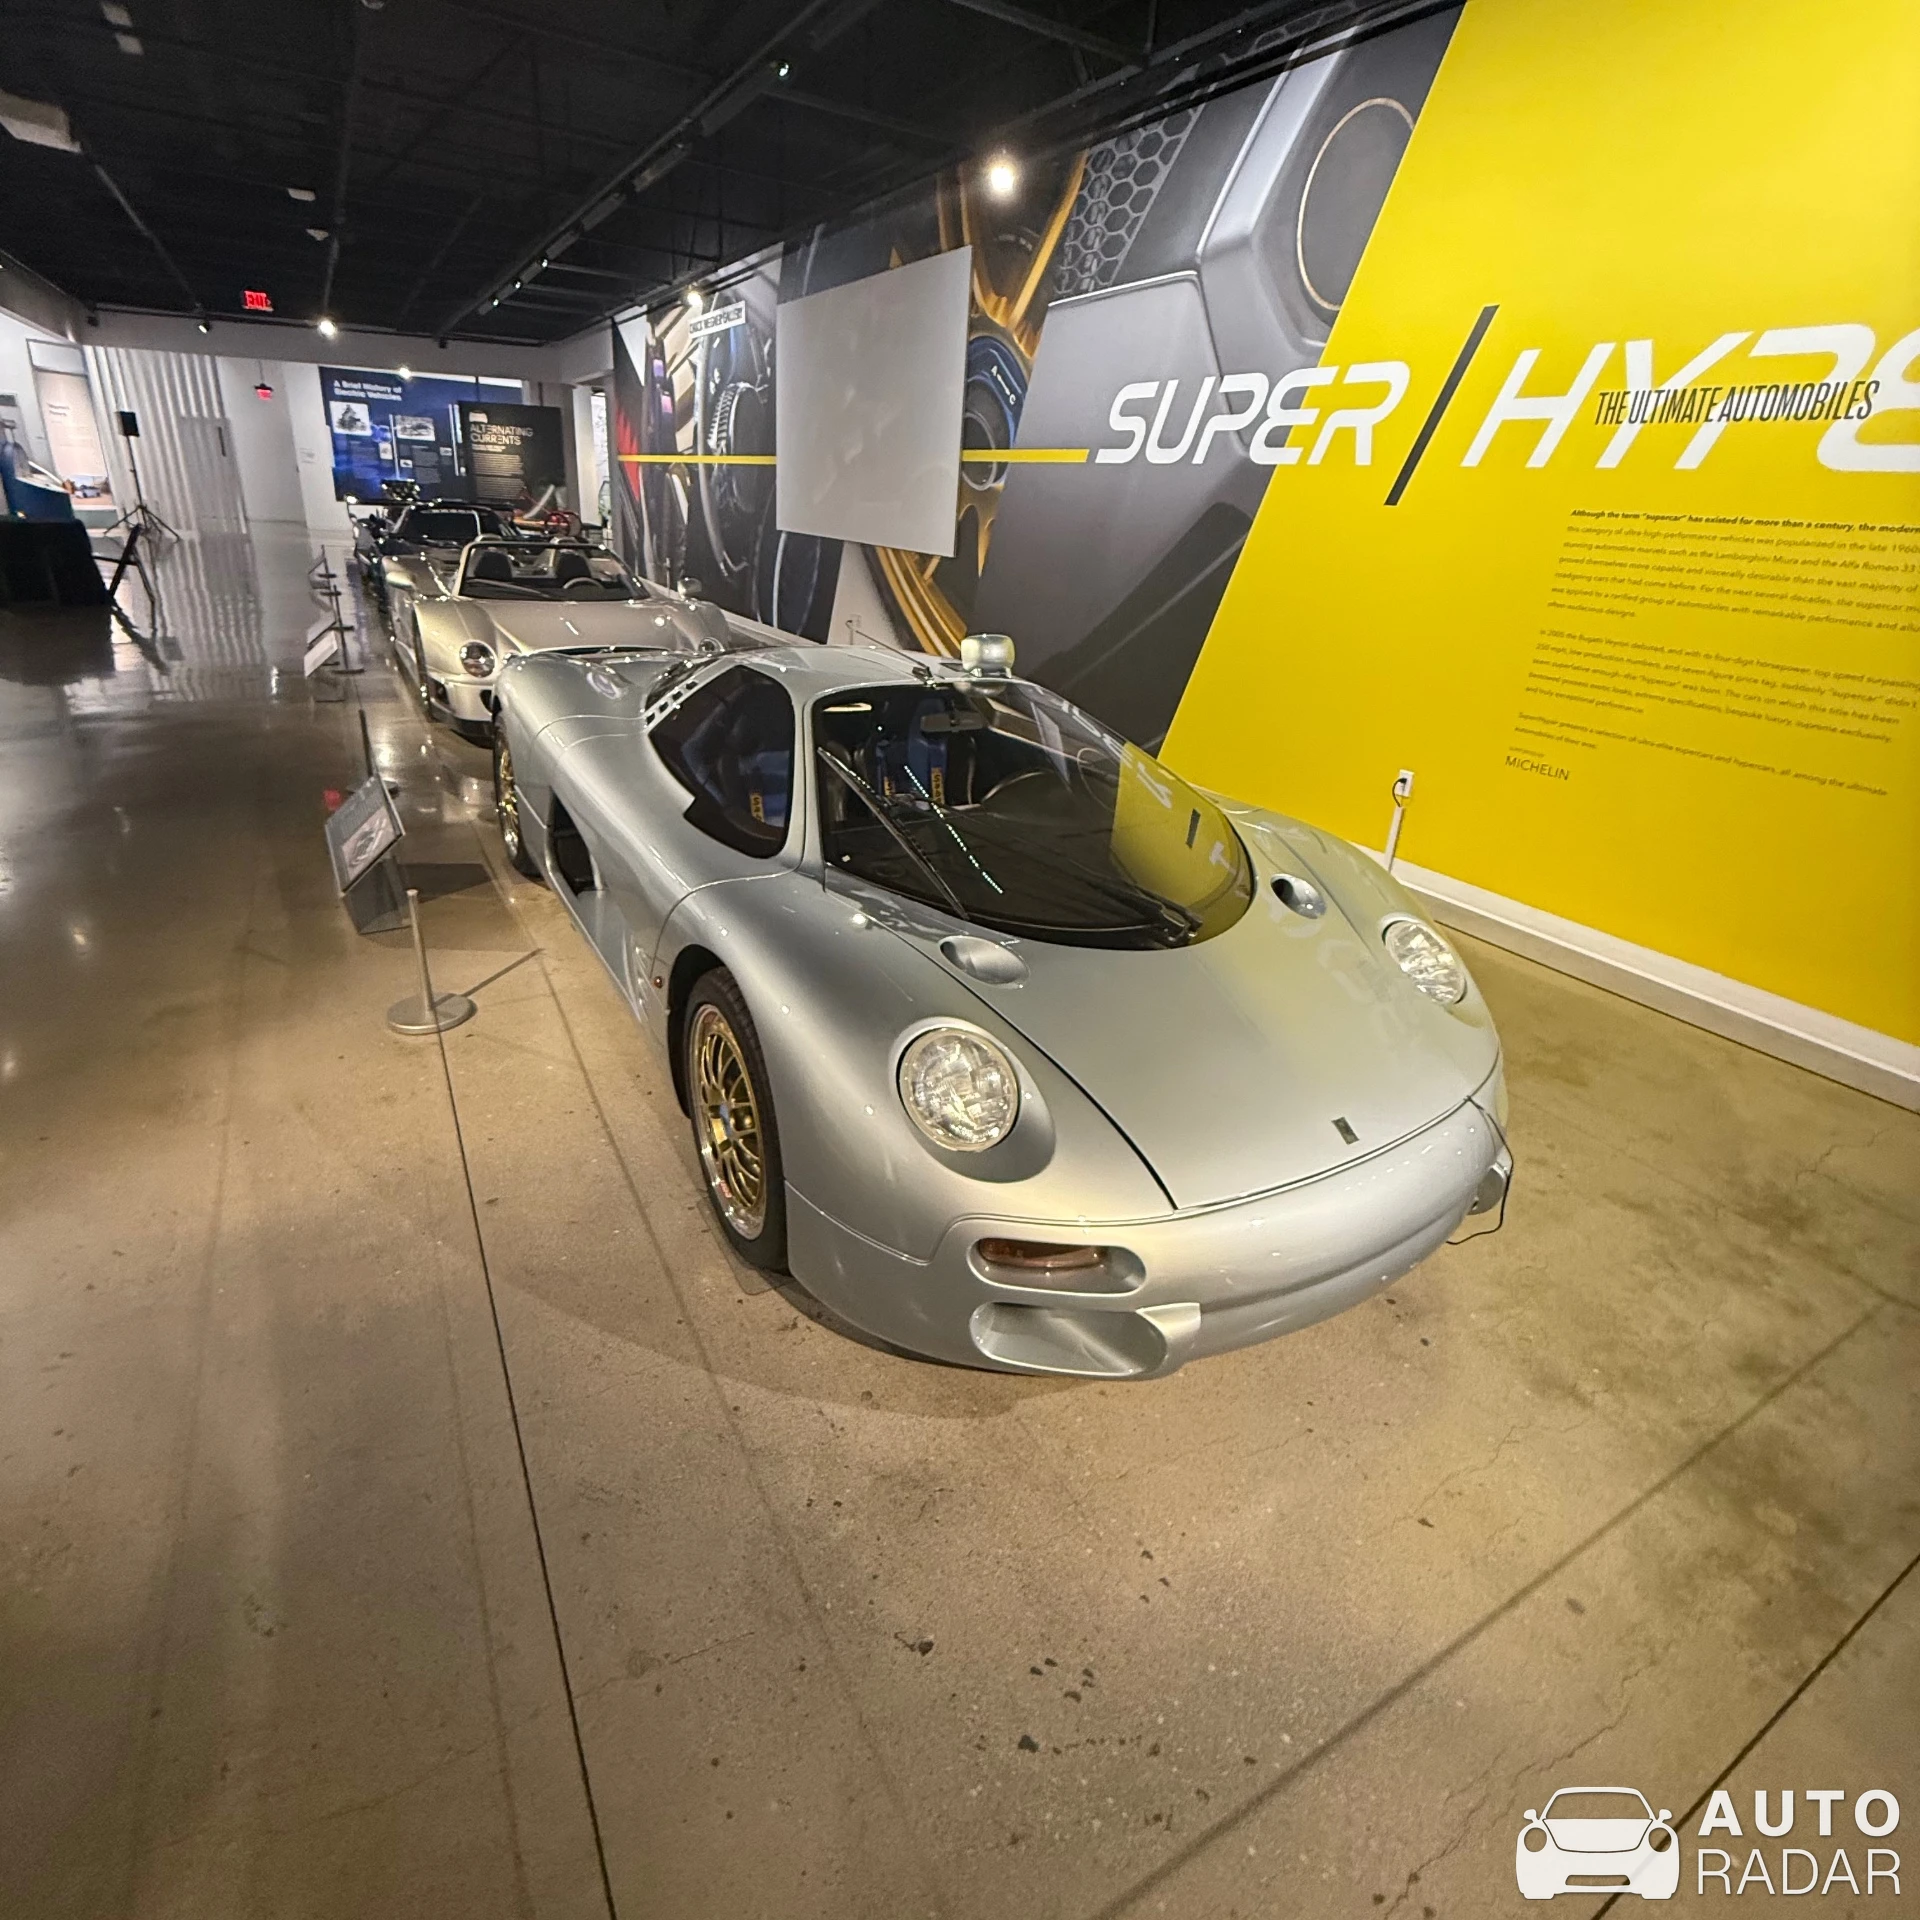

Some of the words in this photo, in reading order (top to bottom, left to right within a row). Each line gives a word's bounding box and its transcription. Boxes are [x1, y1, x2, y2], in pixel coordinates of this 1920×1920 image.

[1095, 360, 1410, 466] SUPER
[1595, 390, 1631, 426] THE
[1627, 386, 1723, 425] ULTIMATE
[1717, 380, 1881, 423] AUTOMOBILES
[470, 423, 534, 437] ALTERNATING
[470, 432, 522, 446] CURRENTS
[1571, 509, 1605, 519] Although
[1688, 514, 1702, 522] has
[1704, 516, 1737, 524] existed
[1739, 516, 1753, 525] for
[1782, 518, 1803, 527] than
[1859, 522, 1876, 531] the
[1849, 541, 1866, 550] the
[1868, 543, 1887, 552] late
[1700, 550, 1713, 558] the
[1773, 554, 1798, 564] Miura
[1800, 558, 1820, 566] and
[1822, 558, 1837, 567] the
[1839, 559, 1859, 569] Alfa
[1862, 560, 1898, 571] Romeo
[1792, 574, 1814, 584] than
[1817, 577, 1833, 586] the
[1836, 580, 1856, 588] vast
[1859, 582, 1902, 594] majority
[1906, 583, 1918, 593] of
[1716, 586, 1730, 594] the
[1837, 597, 1853, 607] the
[1856, 602, 1903, 611] supercar
[1876, 622, 1898, 630] and
[1851, 709, 1869, 720] has
[1872, 713, 1900, 724] been
[1505, 755, 1570, 781] MICHELIN
